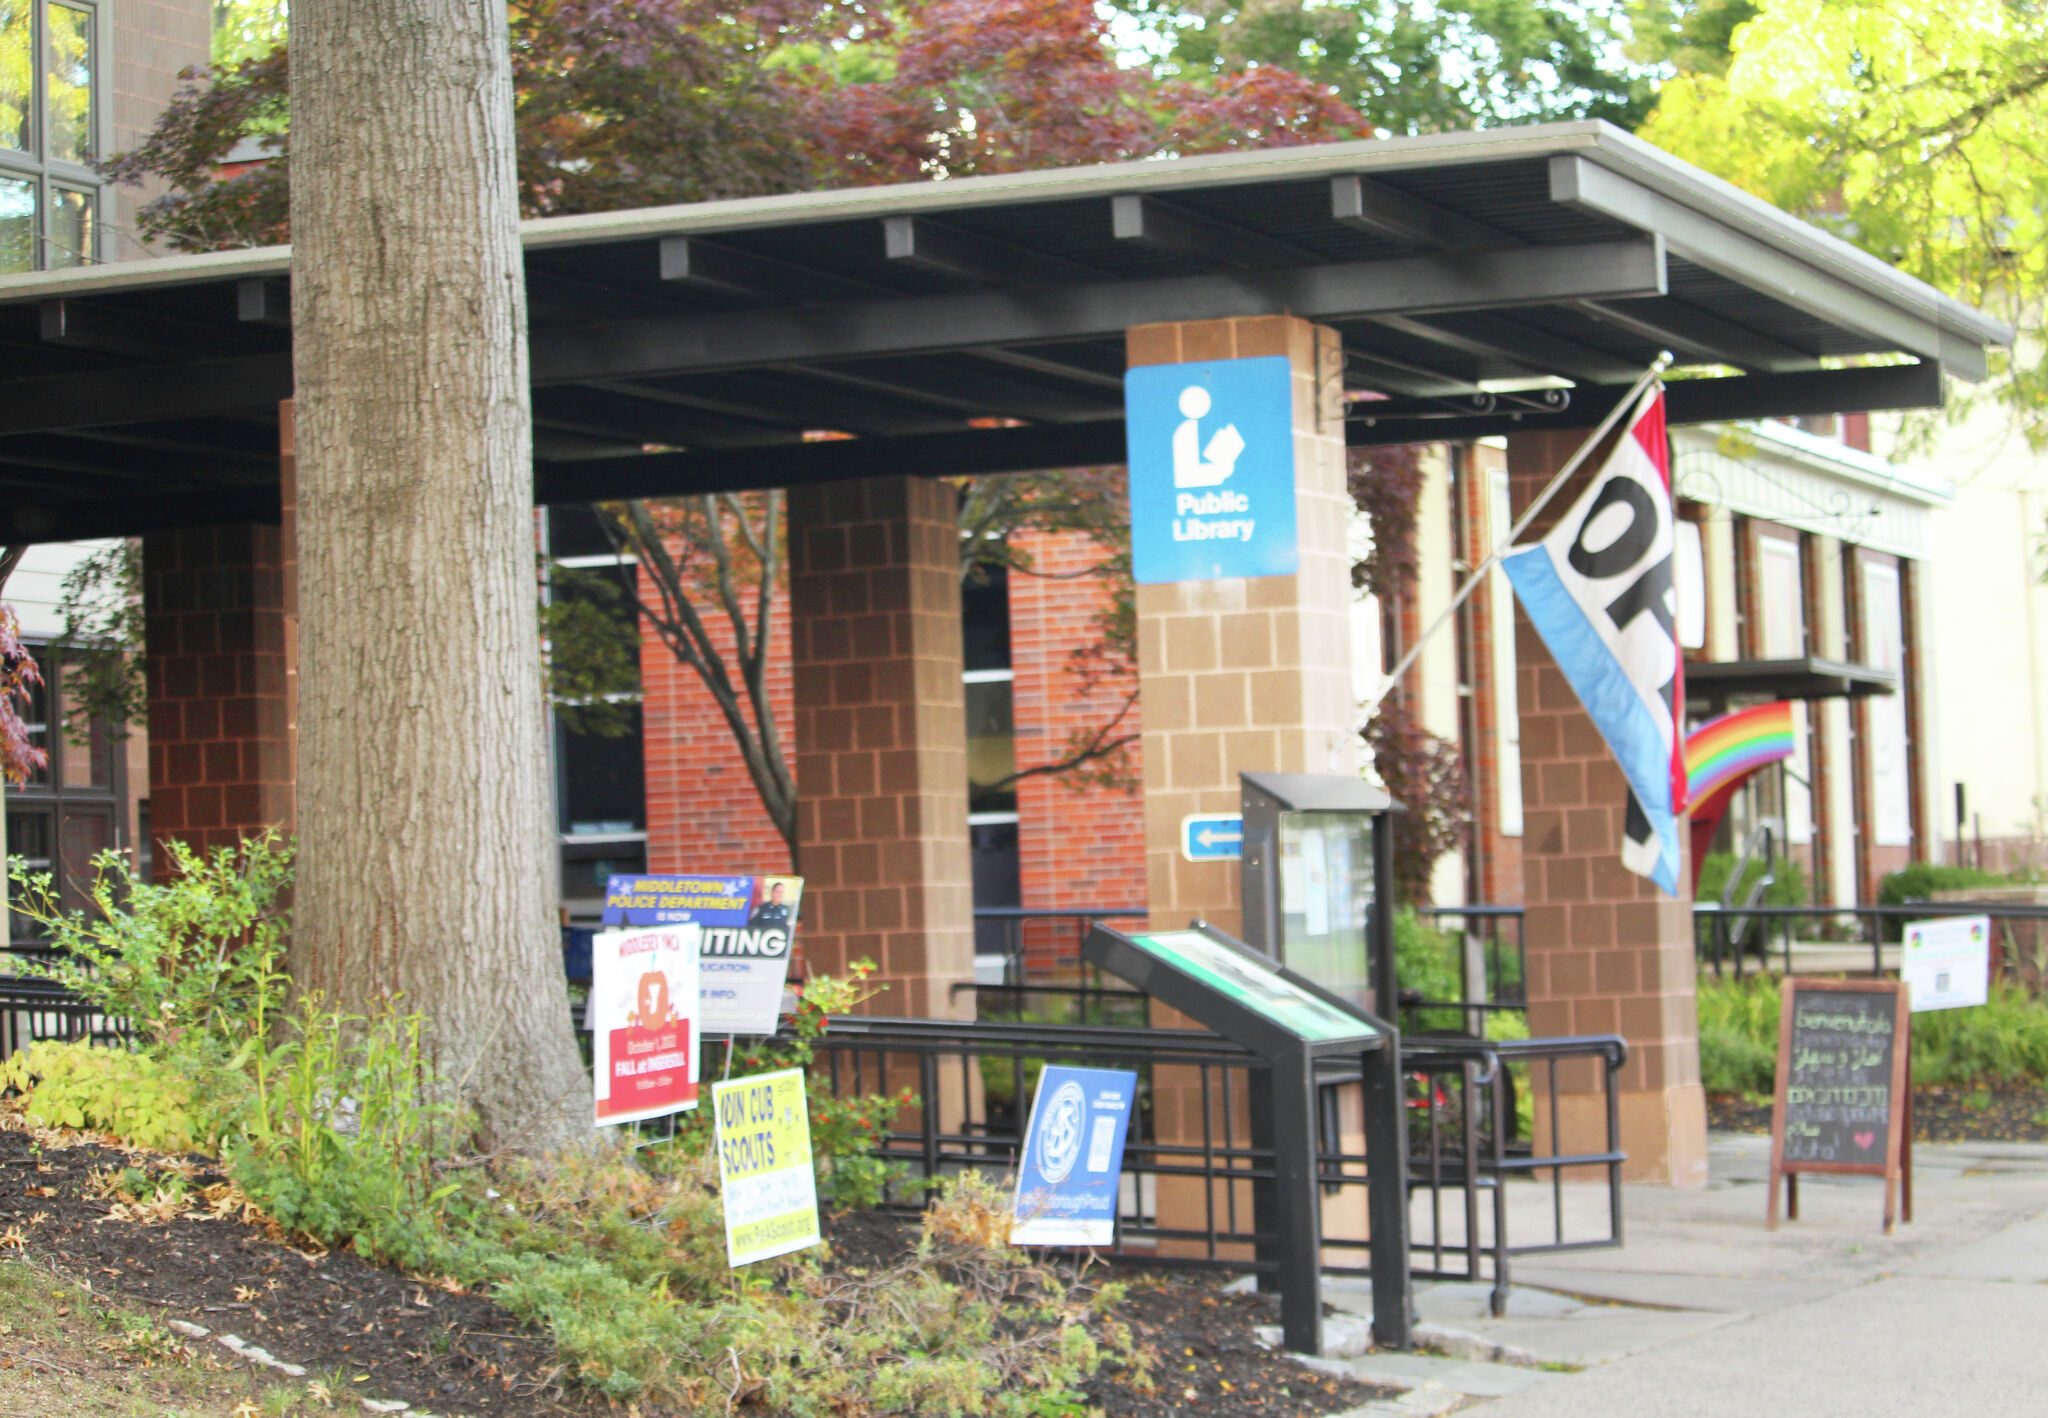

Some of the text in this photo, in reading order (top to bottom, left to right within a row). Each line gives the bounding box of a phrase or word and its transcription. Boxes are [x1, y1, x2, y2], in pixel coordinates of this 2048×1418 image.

[1176, 490, 1249, 515] Public
[1173, 518, 1255, 542] Library
[633, 880, 724, 894] MIDDLETOWN
[607, 895, 748, 911] POLICE DEPARTMENT
[656, 912, 691, 922] IS NOW
[751, 1085, 774, 1123] CUB
[722, 1130, 775, 1175] SCOUTS
